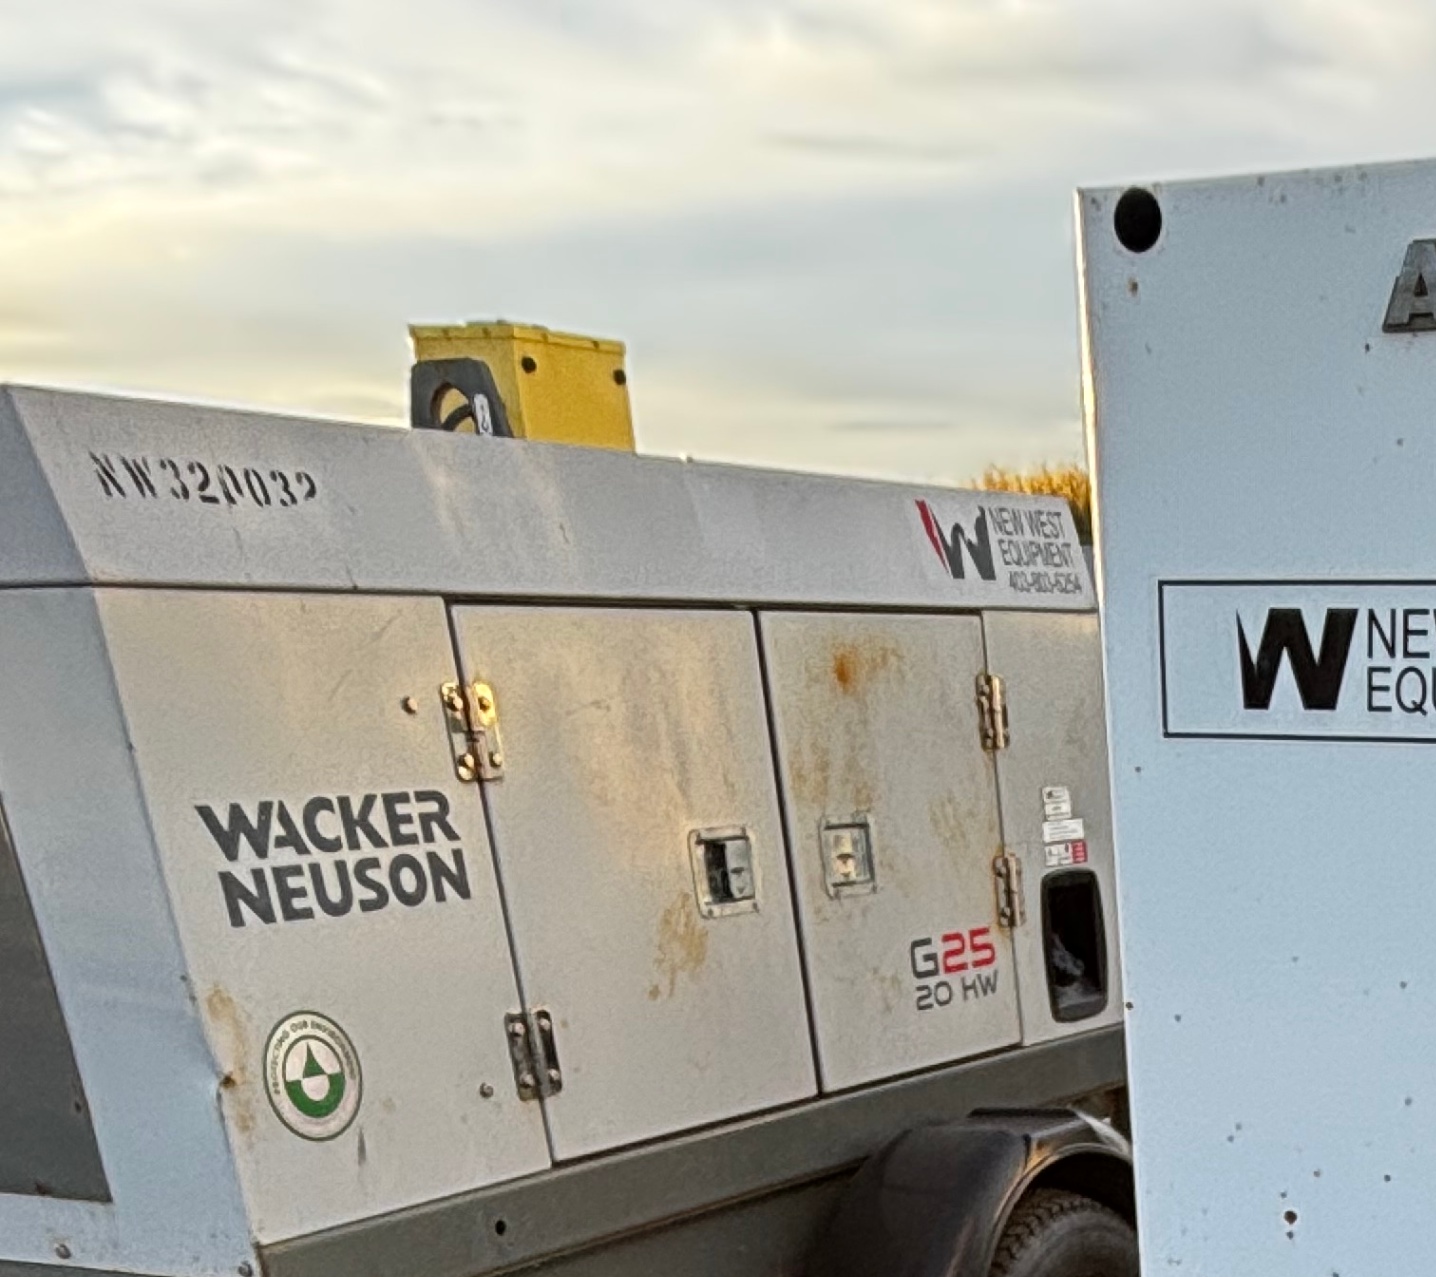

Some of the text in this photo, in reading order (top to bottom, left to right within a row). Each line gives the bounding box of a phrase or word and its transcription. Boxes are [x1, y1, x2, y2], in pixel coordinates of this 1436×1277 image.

[988, 506, 1065, 539] NEW WEST
[998, 539, 1074, 568] EQUIPMENT
[194, 790, 461, 862] WACKER
[218, 848, 472, 927] NEUSON
[911, 927, 997, 979] G25
[915, 980, 954, 1011] 20
